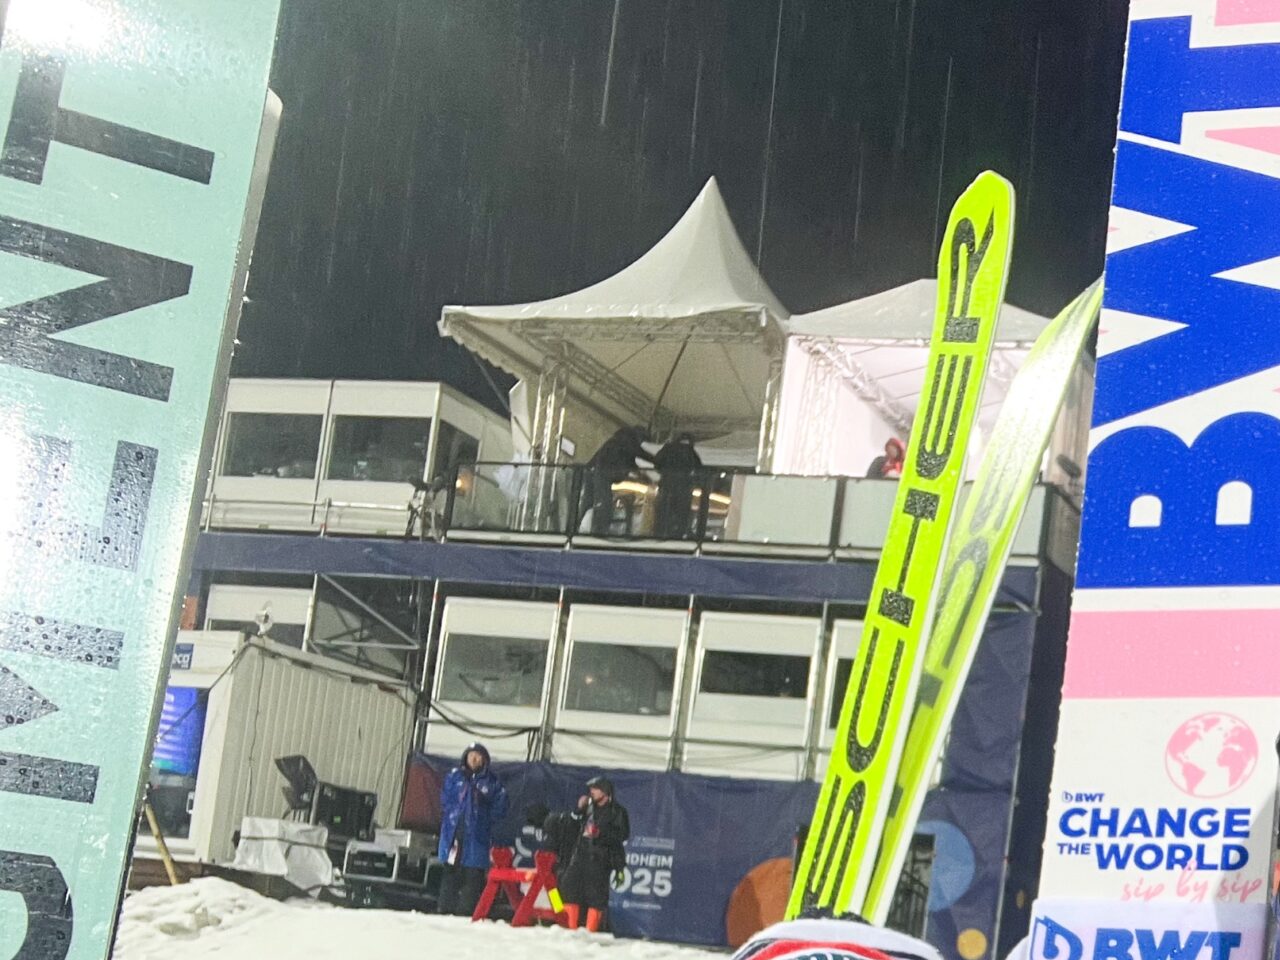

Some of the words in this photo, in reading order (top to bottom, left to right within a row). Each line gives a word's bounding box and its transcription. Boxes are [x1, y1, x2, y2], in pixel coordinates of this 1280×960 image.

[800, 206, 995, 912] SCHER
[1059, 807, 1251, 838] CHANGE
[1057, 843, 1091, 855] THE
[1095, 843, 1249, 871] WORLD
[609, 866, 672, 897] 025
[1121, 878, 1165, 901] sip
[1176, 860, 1209, 900] by
[1216, 875, 1263, 904] sip
